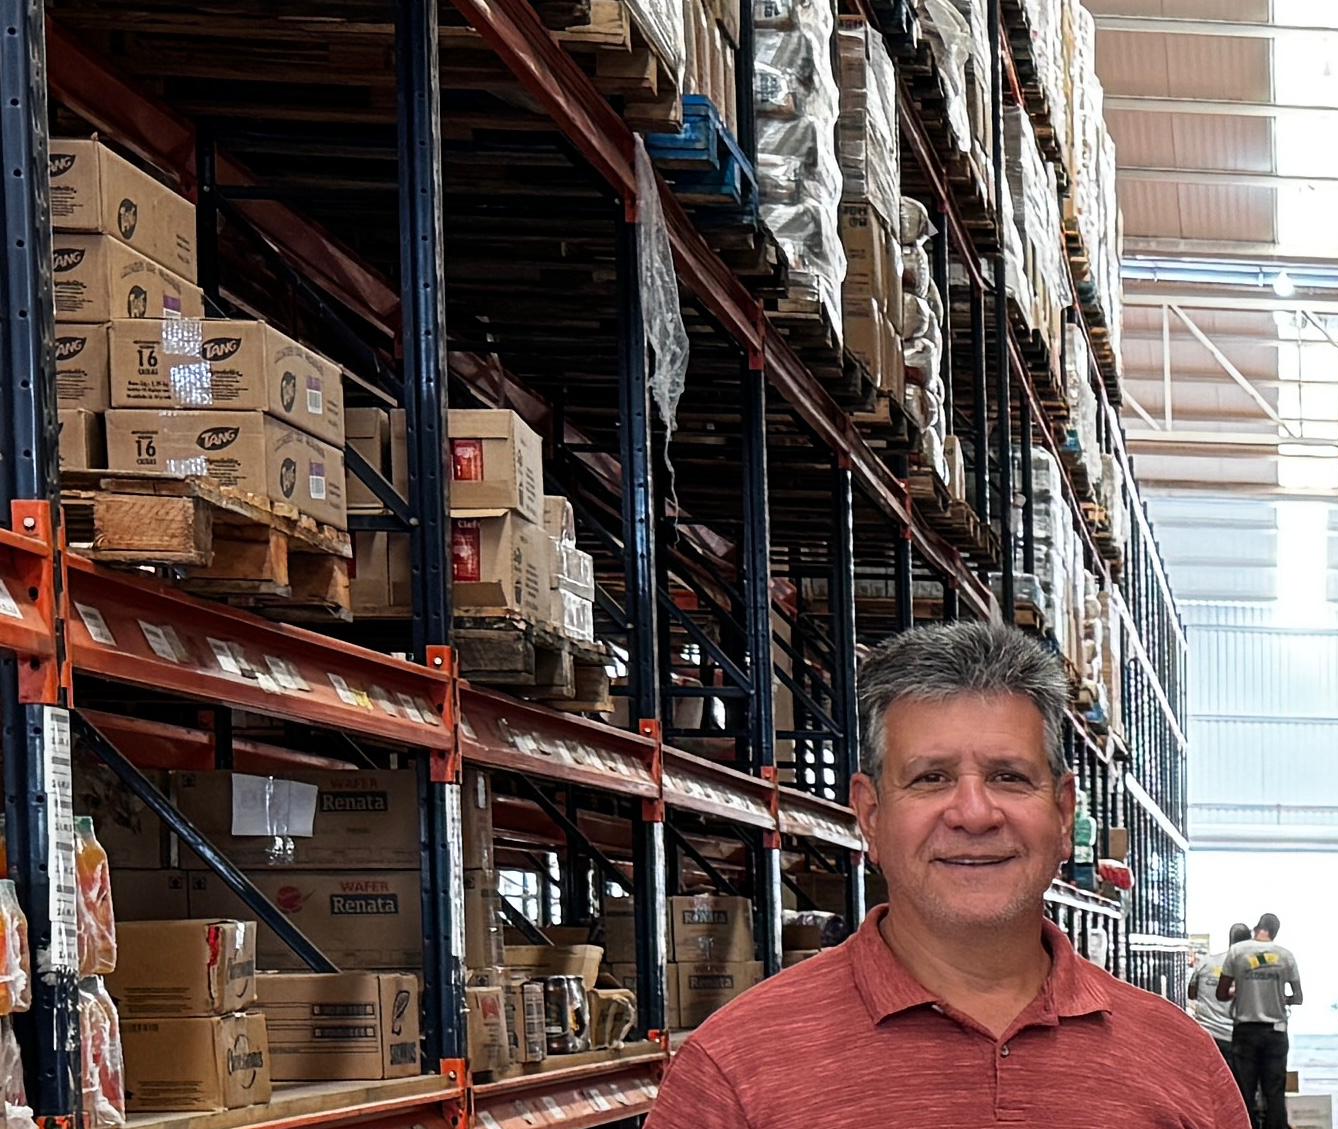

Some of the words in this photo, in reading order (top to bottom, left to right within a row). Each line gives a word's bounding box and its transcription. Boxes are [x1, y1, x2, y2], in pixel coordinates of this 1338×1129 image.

[204, 340, 237, 359] TANG
[138, 350, 158, 367] 16
[203, 430, 236, 448] TANG
[136, 440, 156, 457] 16
[330, 778, 378, 789] WAFER
[323, 794, 386, 811] Renata
[339, 881, 390, 892] WAFER
[332, 897, 396, 913] Renata
